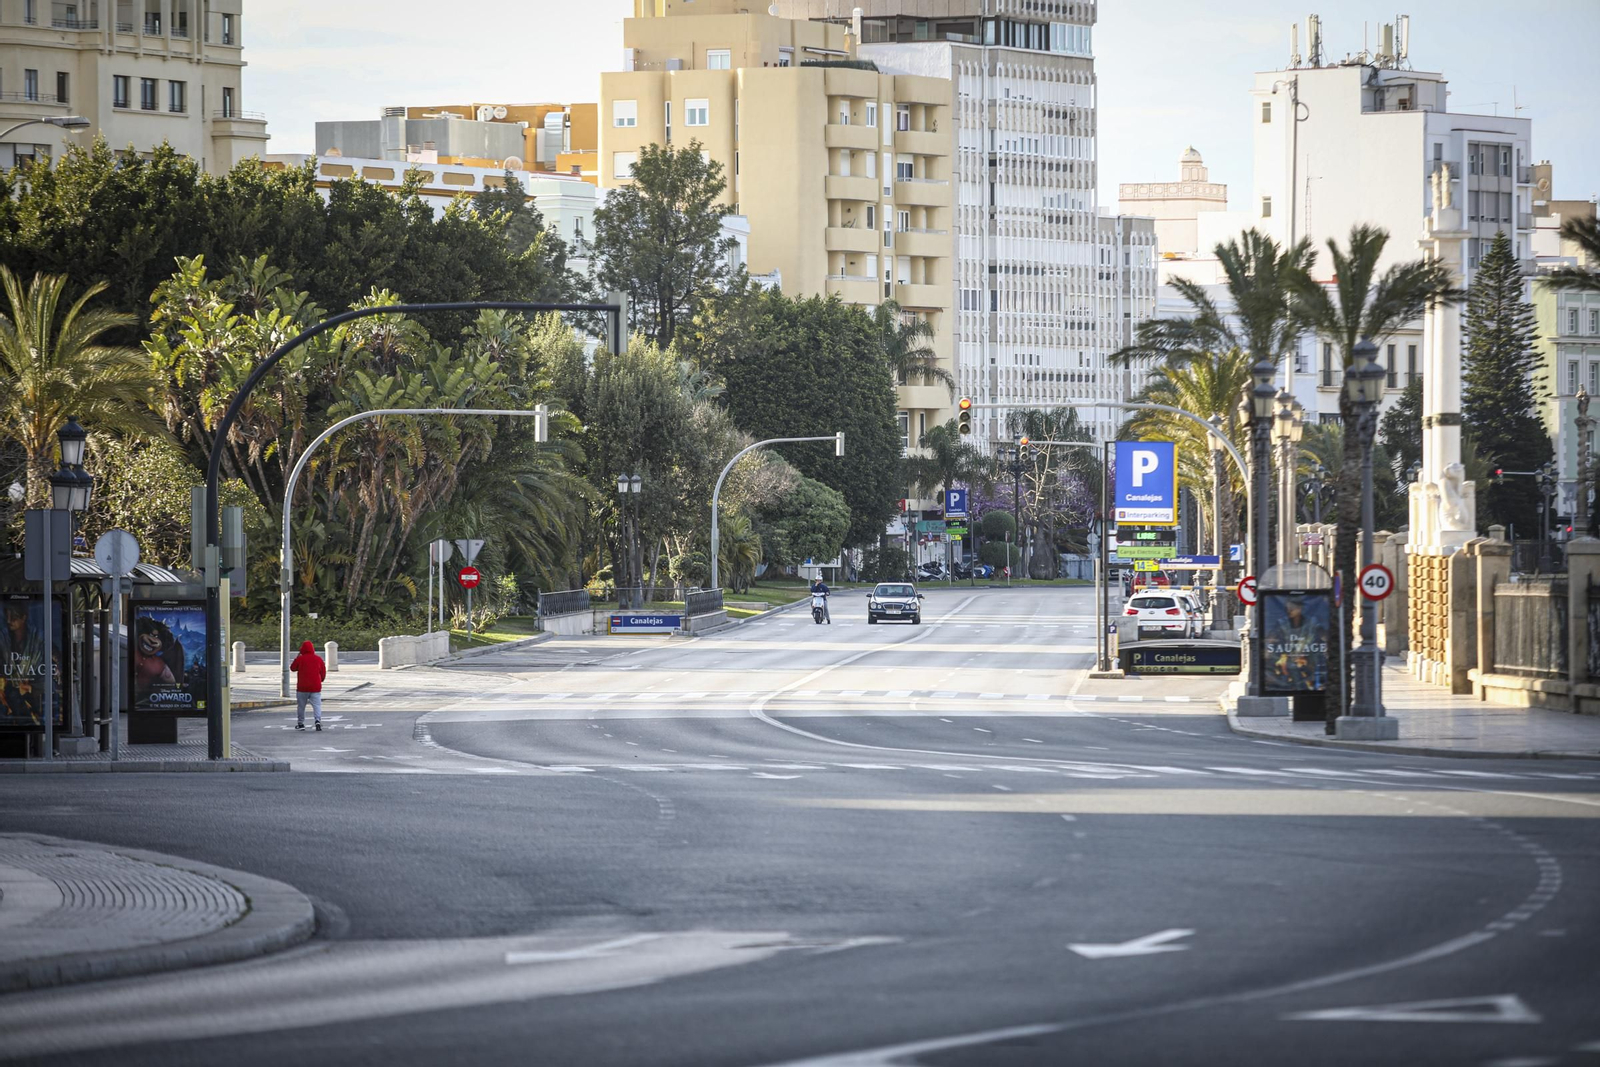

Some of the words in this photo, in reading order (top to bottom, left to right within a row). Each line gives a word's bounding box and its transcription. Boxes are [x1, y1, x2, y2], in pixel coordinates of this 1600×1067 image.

[1132, 450, 1159, 487] P
[950, 492, 960, 506] P
[1125, 493, 1163, 503] Canalejas
[1127, 511, 1170, 520] Interparking
[1136, 532, 1157, 540] LIBRE
[1136, 561, 1145, 570] 14
[1365, 576, 1386, 588] 40
[630, 617, 663, 625] Canalejas
[1109, 625, 1116, 633] P
[1267, 643, 1328, 653] SAUVAGE
[11, 652, 30, 661] Dior
[1133, 653, 1142, 664] P
[1154, 653, 1196, 664] Canalejas
[149, 693, 192, 703] ONWARD
